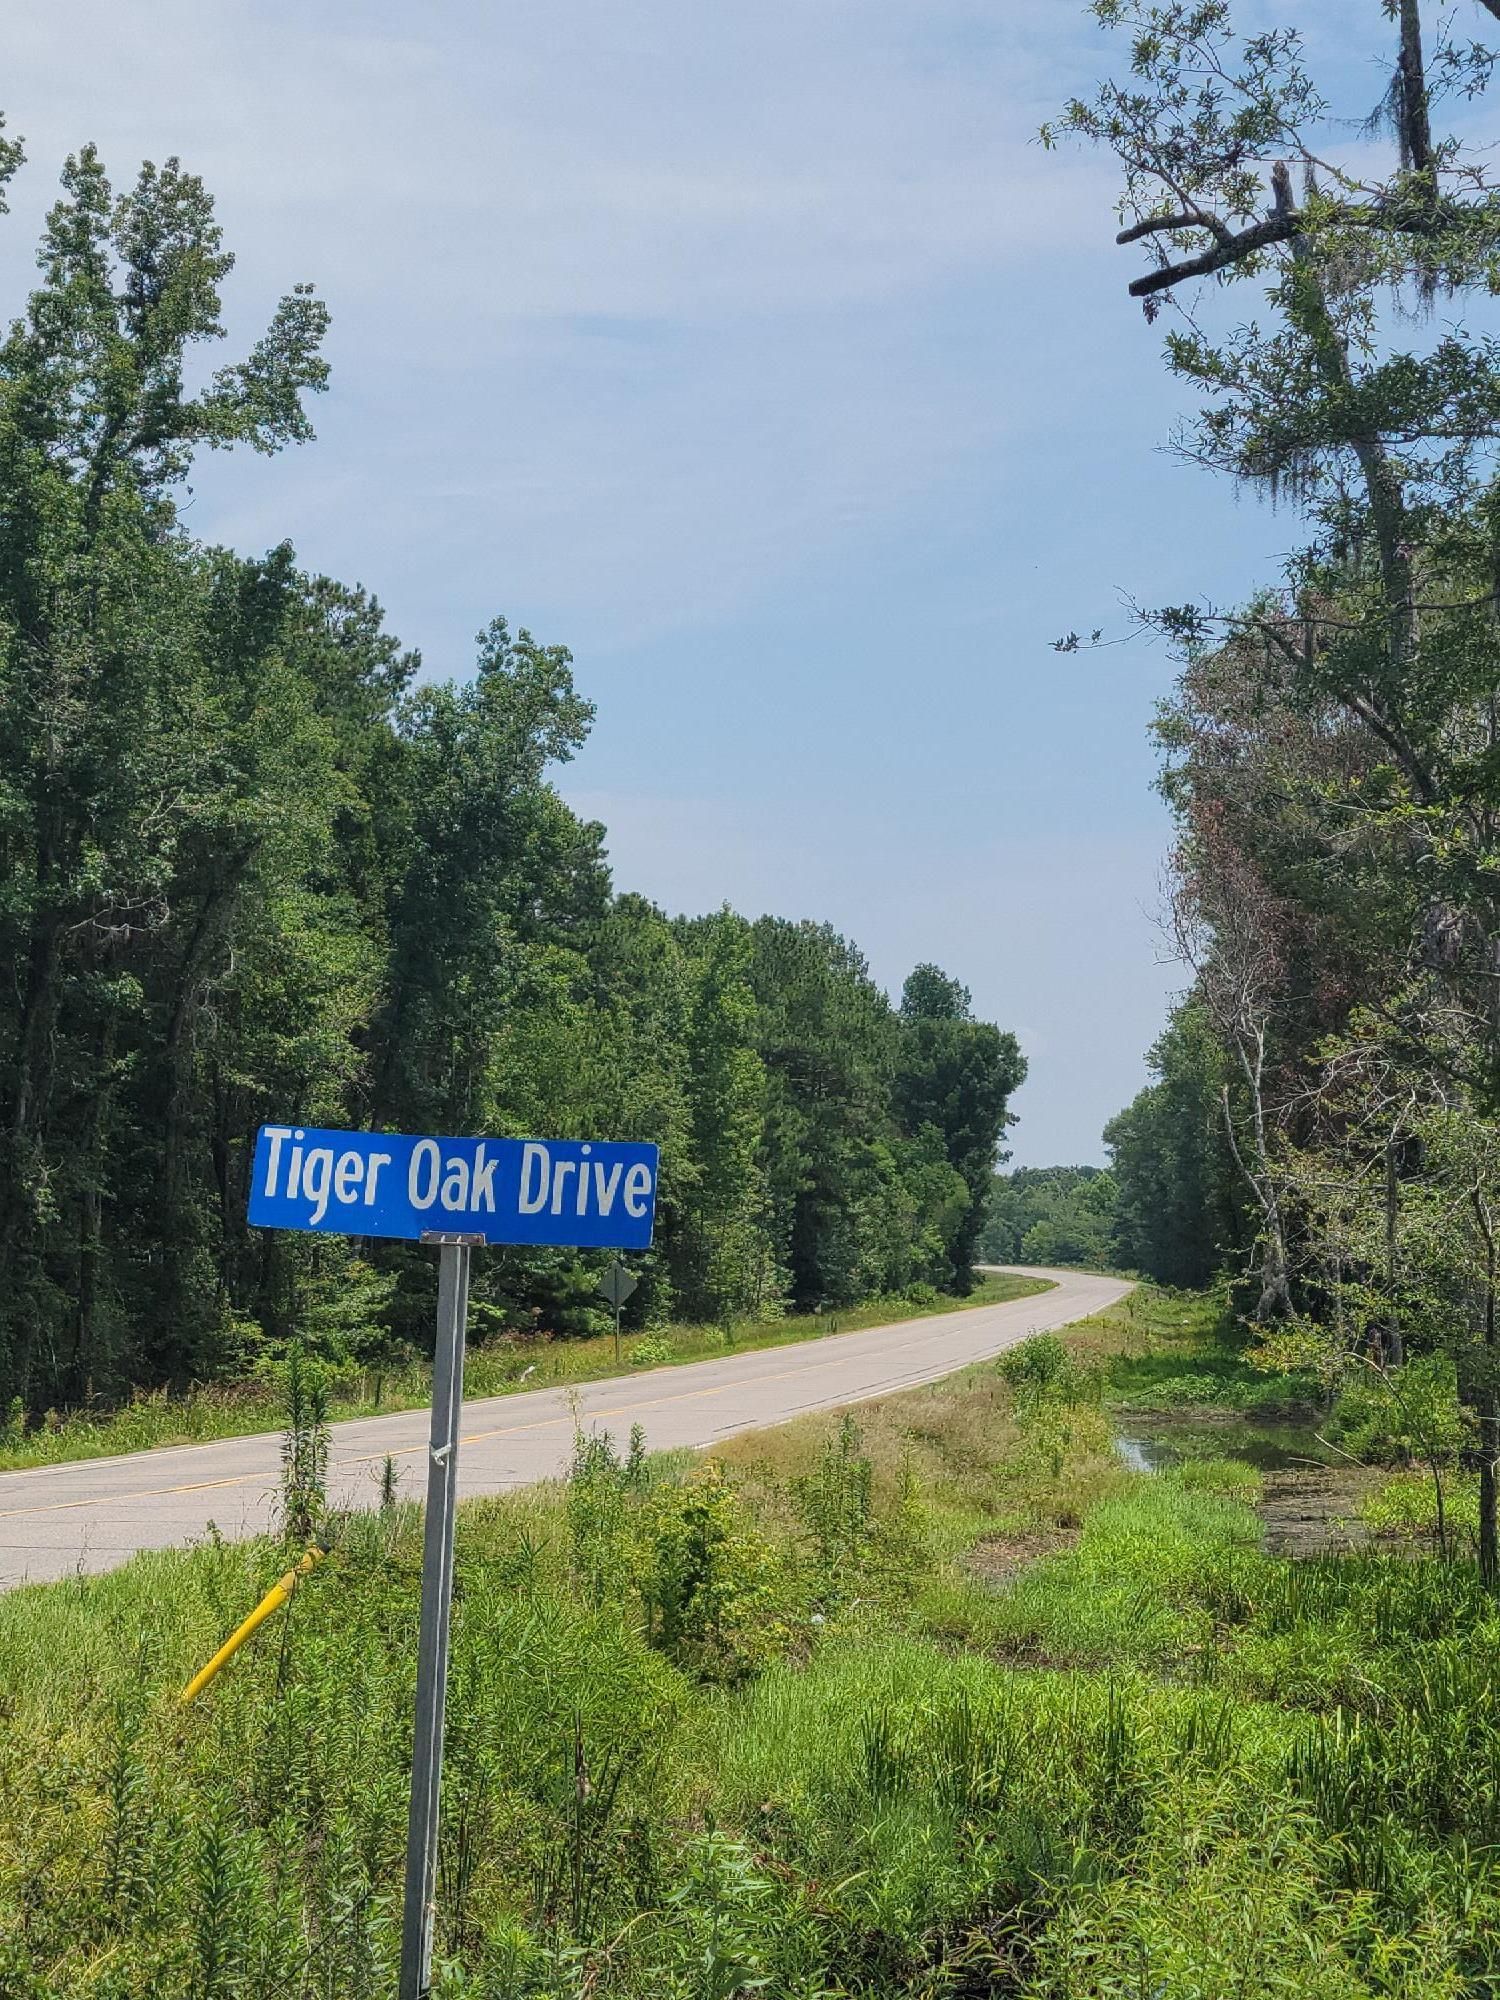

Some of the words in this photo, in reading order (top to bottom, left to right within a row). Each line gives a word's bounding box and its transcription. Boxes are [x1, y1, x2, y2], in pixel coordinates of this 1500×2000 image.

[264, 1127, 392, 1226] Tiger
[408, 1139, 500, 1213] Oak
[518, 1143, 653, 1218] Drive
